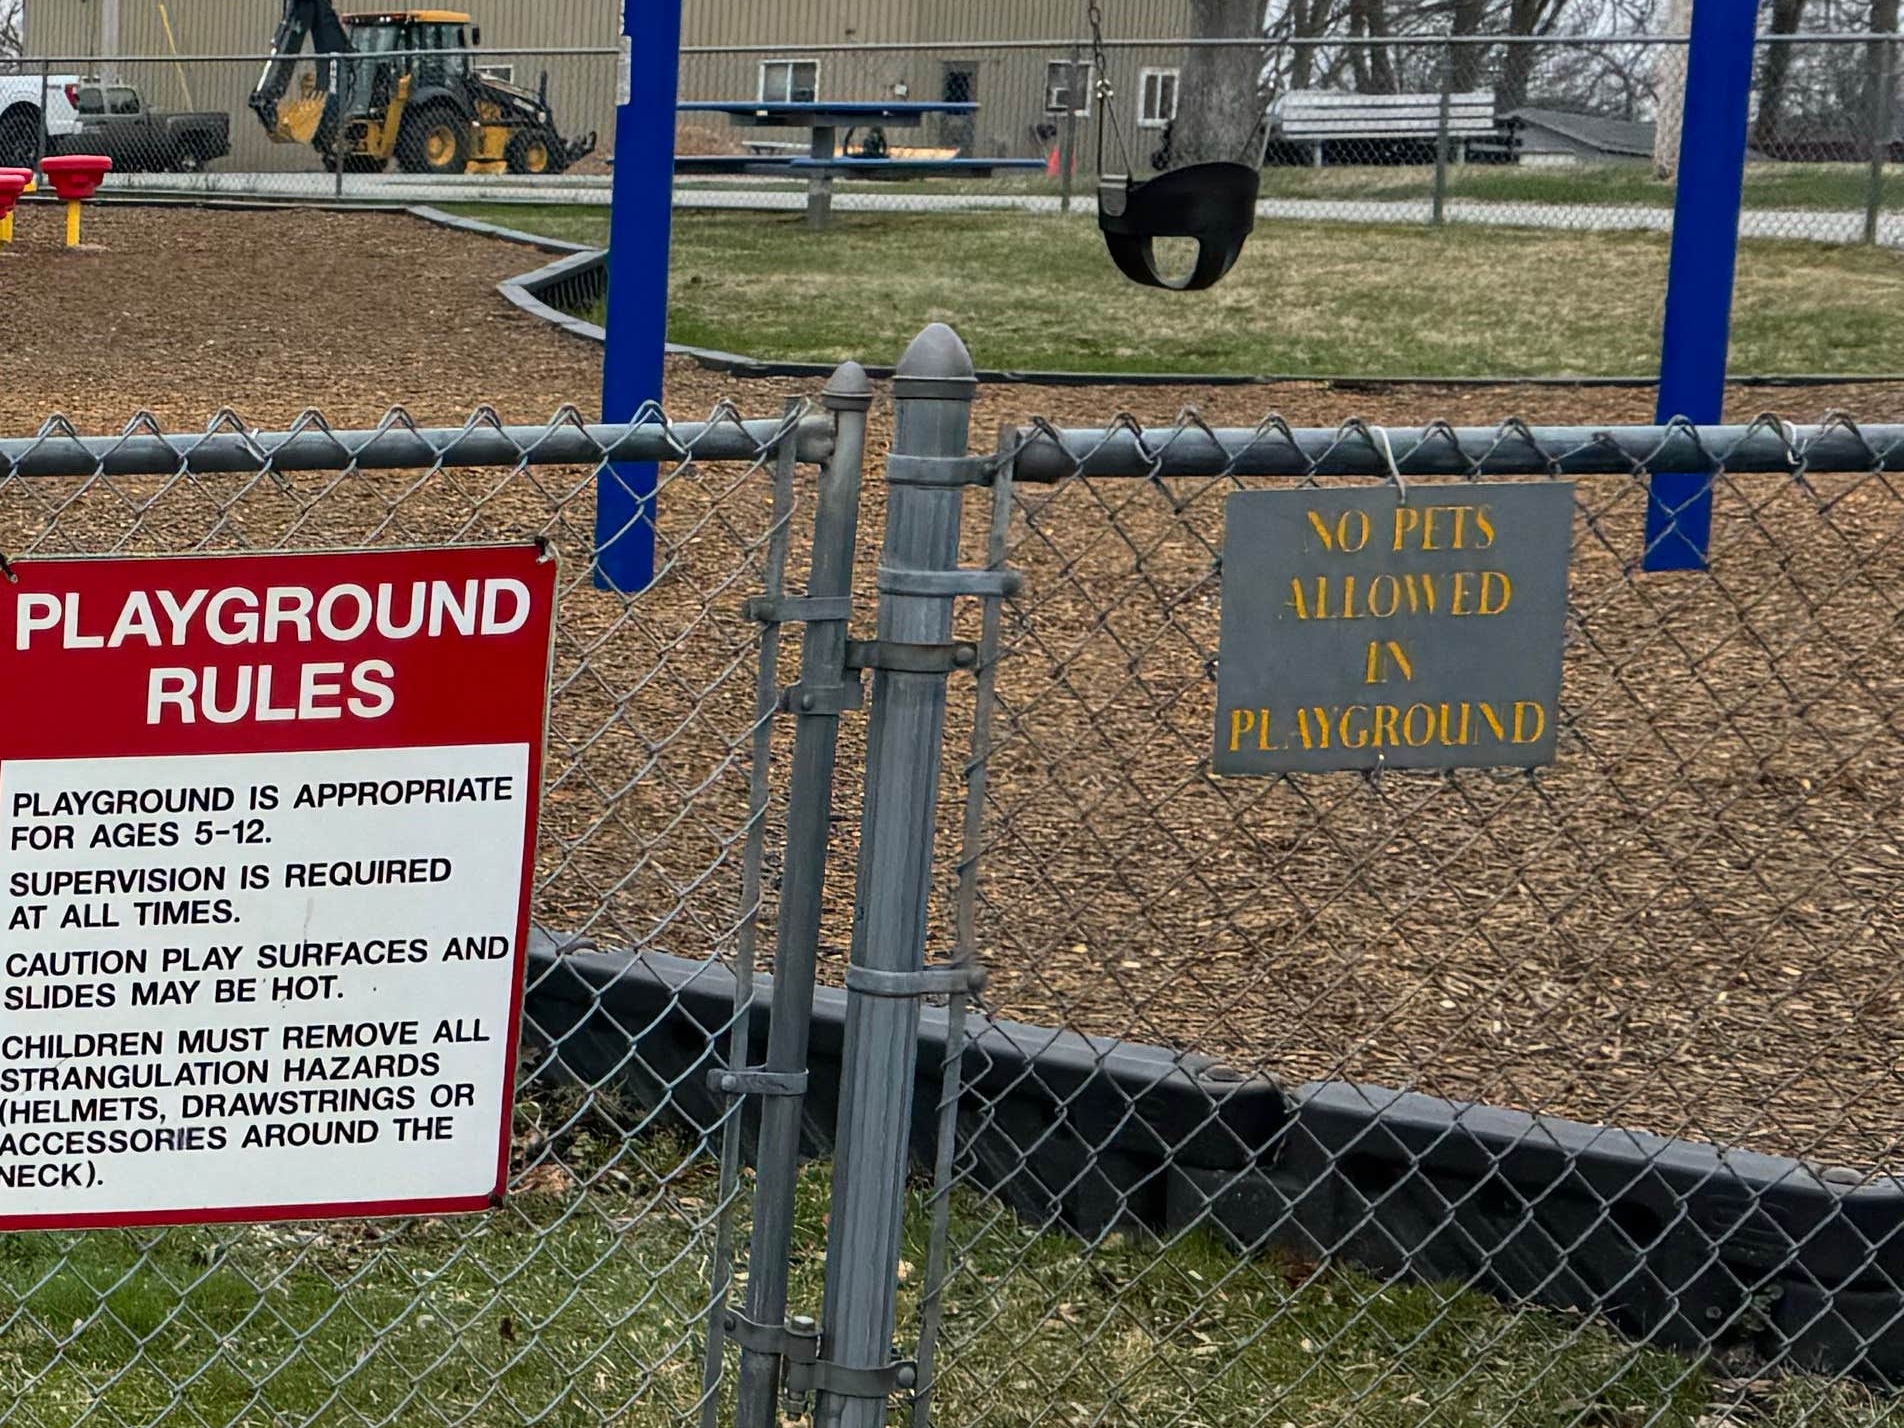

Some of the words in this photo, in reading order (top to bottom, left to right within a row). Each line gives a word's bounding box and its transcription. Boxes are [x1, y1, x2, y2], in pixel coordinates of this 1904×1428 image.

[1304, 511, 1371, 550] NO
[1393, 507, 1495, 551] PETS
[17, 579, 530, 650] PLAYGROUND
[1281, 572, 1512, 619] ALLOWED
[1366, 641, 1412, 684] IN
[147, 660, 394, 724] RULES
[1229, 701, 1545, 752] PLAYGROUND
[14, 787, 234, 817] PLAYGROUND
[250, 785, 278, 810] IS
[294, 777, 512, 808] APPROPRIATE
[12, 826, 74, 850] FOR
[90, 822, 178, 848] AGES
[195, 819, 271, 845] 5-12.
[9, 867, 226, 897] SUPERVISION
[241, 865, 269, 889] IS
[285, 859, 451, 888] REQUIRED
[9, 906, 47, 929] AT
[60, 903, 119, 928] ALL
[134, 899, 239, 925] TIMES.
[6, 949, 146, 977] CAUTION
[163, 946, 243, 972] PLAY
[257, 939, 427, 968] SURFACES
[442, 937, 508, 961] AND
[5, 983, 115, 1010] SLIDES
[132, 980, 200, 1006] MAY
[215, 978, 256, 1002] BE
[272, 975, 343, 1000] HOT.
[2, 1031, 162, 1059] CHILDREN
[179, 1028, 269, 1053] MUST
[283, 1021, 418, 1049] REMOVE
[433, 1019, 489, 1043] ALL
[1, 1060, 268, 1092] STRANGULATION
[284, 1053, 439, 1082] HAZARDS
[0, 1097, 167, 1125] (HELMETS,
[182, 1086, 414, 1118] DRAWSTRINGS
[431, 1084, 474, 1107] OR
[242, 1120, 378, 1148] AROUND
[393, 1117, 453, 1141] THE
